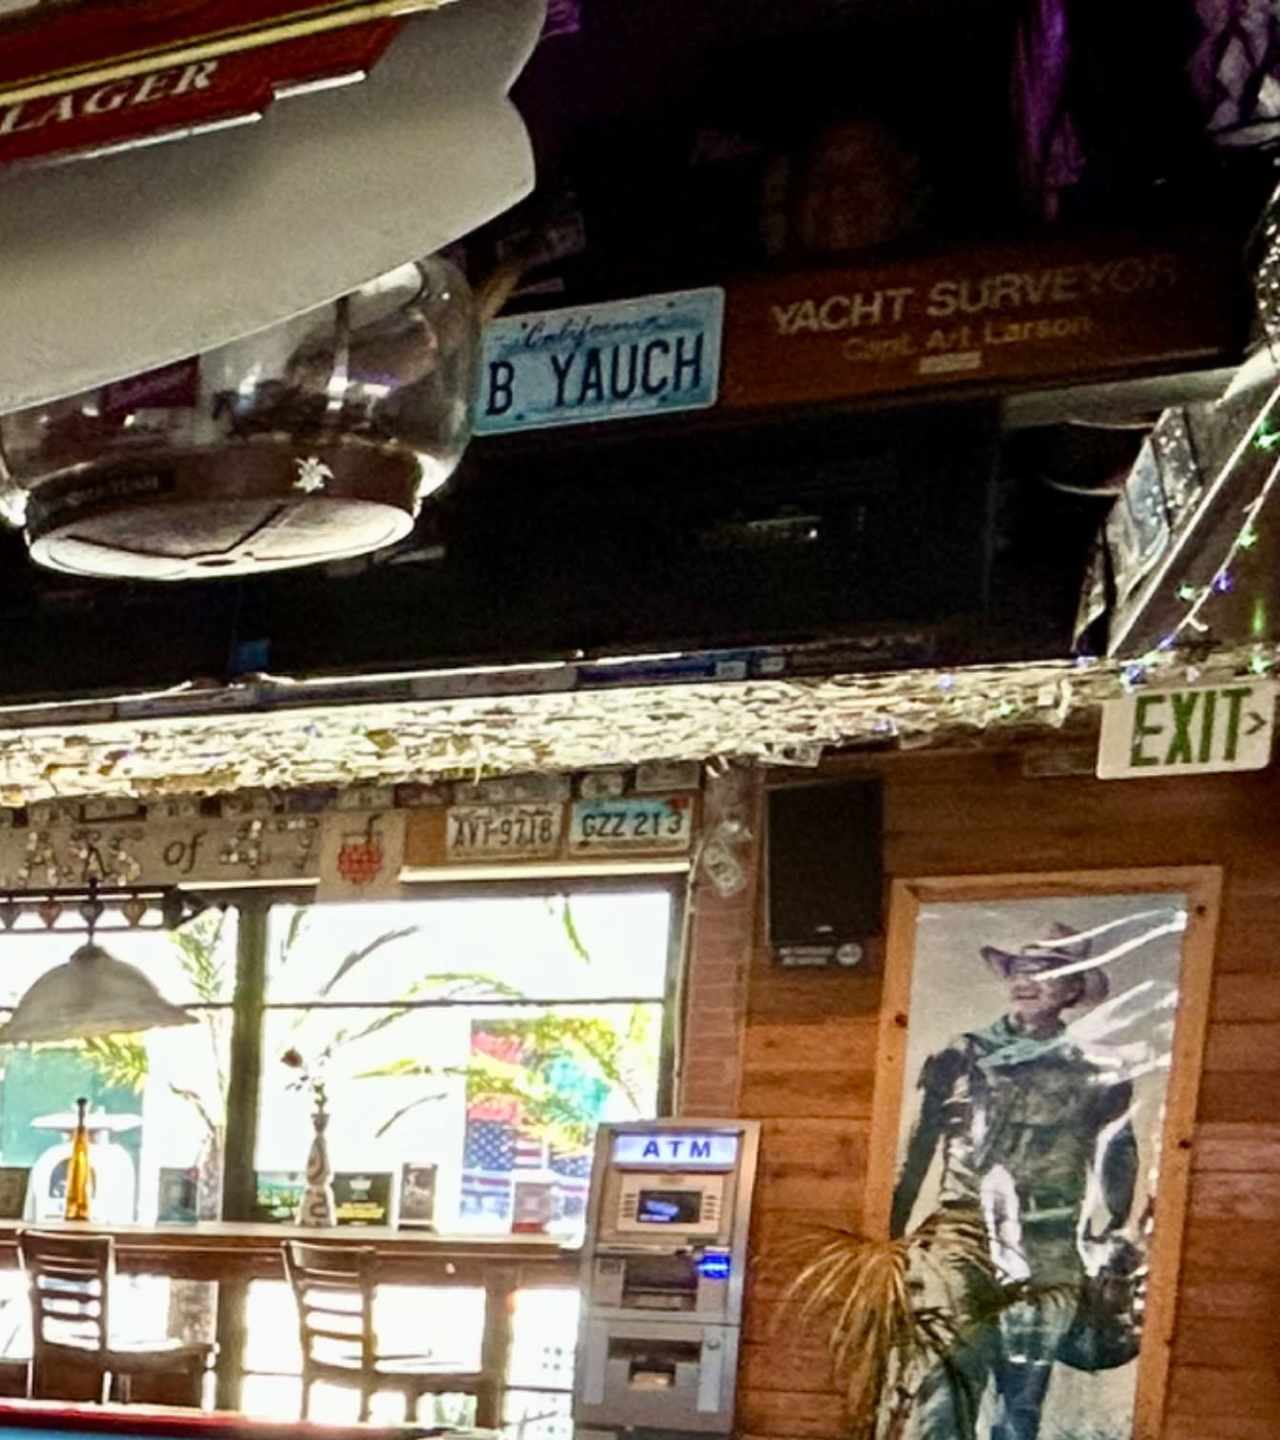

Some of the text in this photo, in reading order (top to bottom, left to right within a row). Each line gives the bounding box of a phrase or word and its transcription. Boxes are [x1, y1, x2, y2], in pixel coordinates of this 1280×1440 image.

[769, 286, 915, 336] YACHT
[486, 331, 705, 417] B YAUCH
[1130, 686, 1253, 768] EXIT
[163, 829, 208, 875] of
[642, 1140, 712, 1158] ATM
